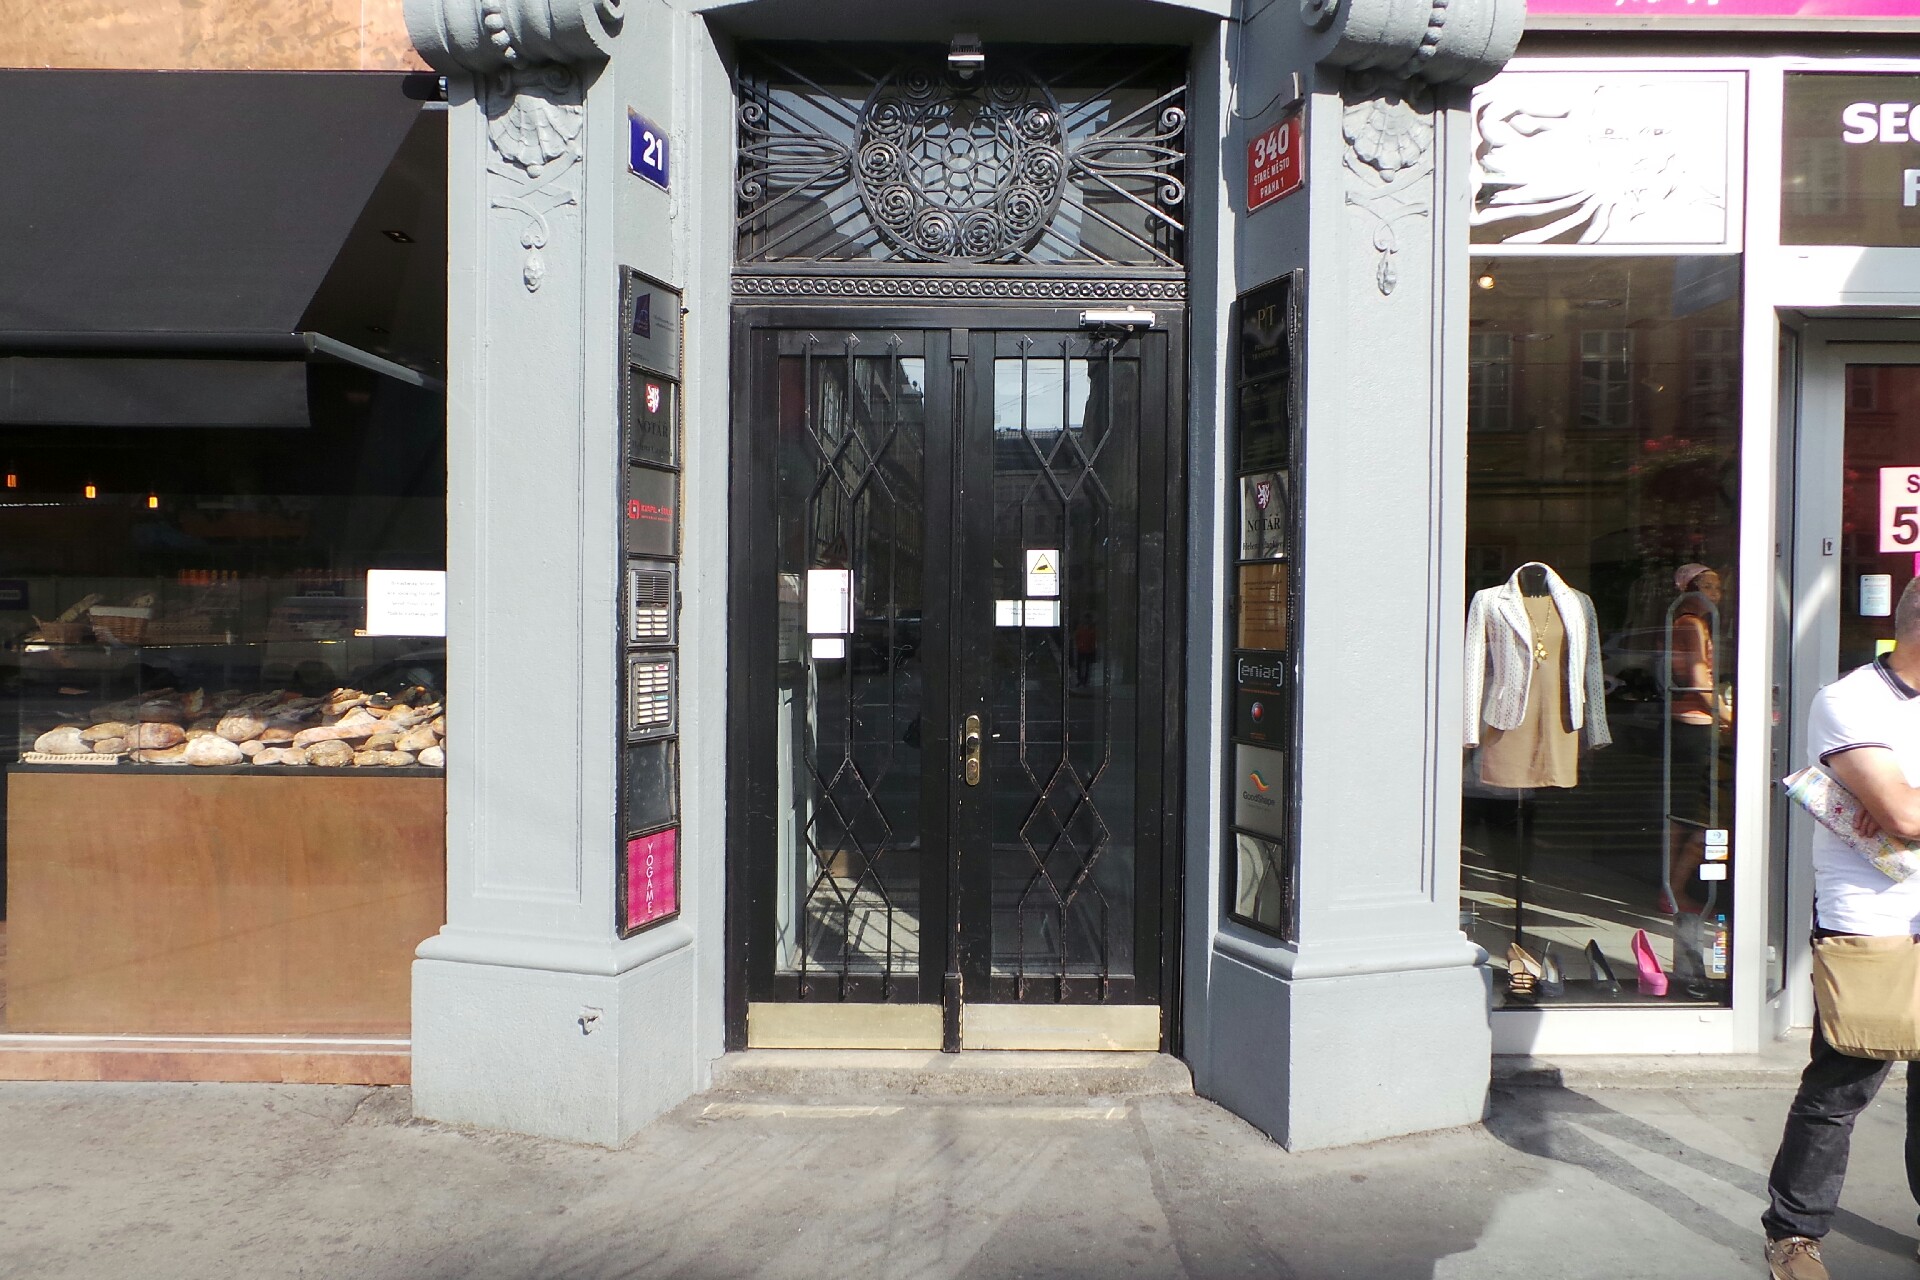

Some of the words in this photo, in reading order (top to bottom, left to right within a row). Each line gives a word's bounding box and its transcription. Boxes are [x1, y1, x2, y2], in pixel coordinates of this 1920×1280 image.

[642, 131, 663, 171] 21
[1254, 123, 1289, 169] 340
[1253, 165, 1271, 186] STARÉ
[1260, 180, 1280, 199] PRAHA
[1280, 176, 1284, 188] 1
[1257, 304, 1276, 330] PT
[646, 842, 654, 914] YOGAME
